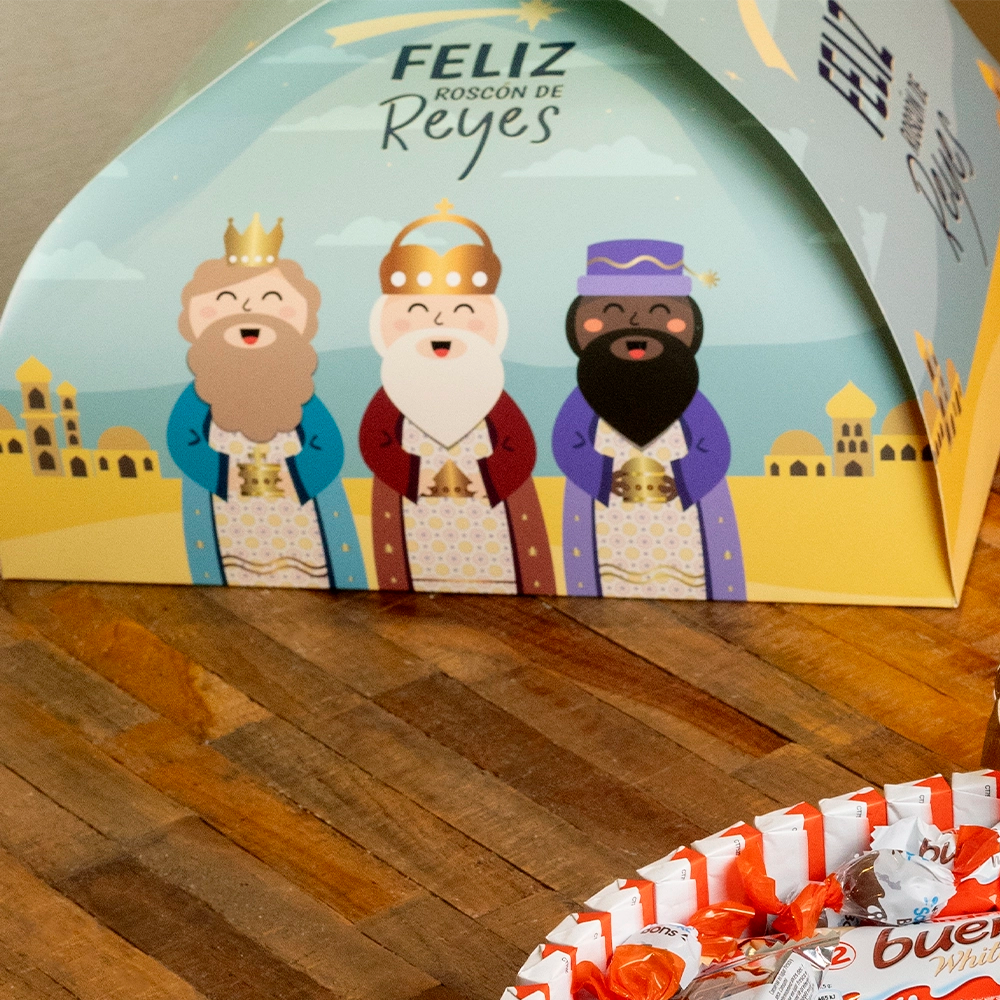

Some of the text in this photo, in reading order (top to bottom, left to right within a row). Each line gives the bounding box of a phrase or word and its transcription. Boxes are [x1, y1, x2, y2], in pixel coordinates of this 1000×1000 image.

[391, 41, 577, 80] FELIZ
[433, 81, 564, 101] ROSCÓN DE
[379, 93, 560, 181] Reyes
